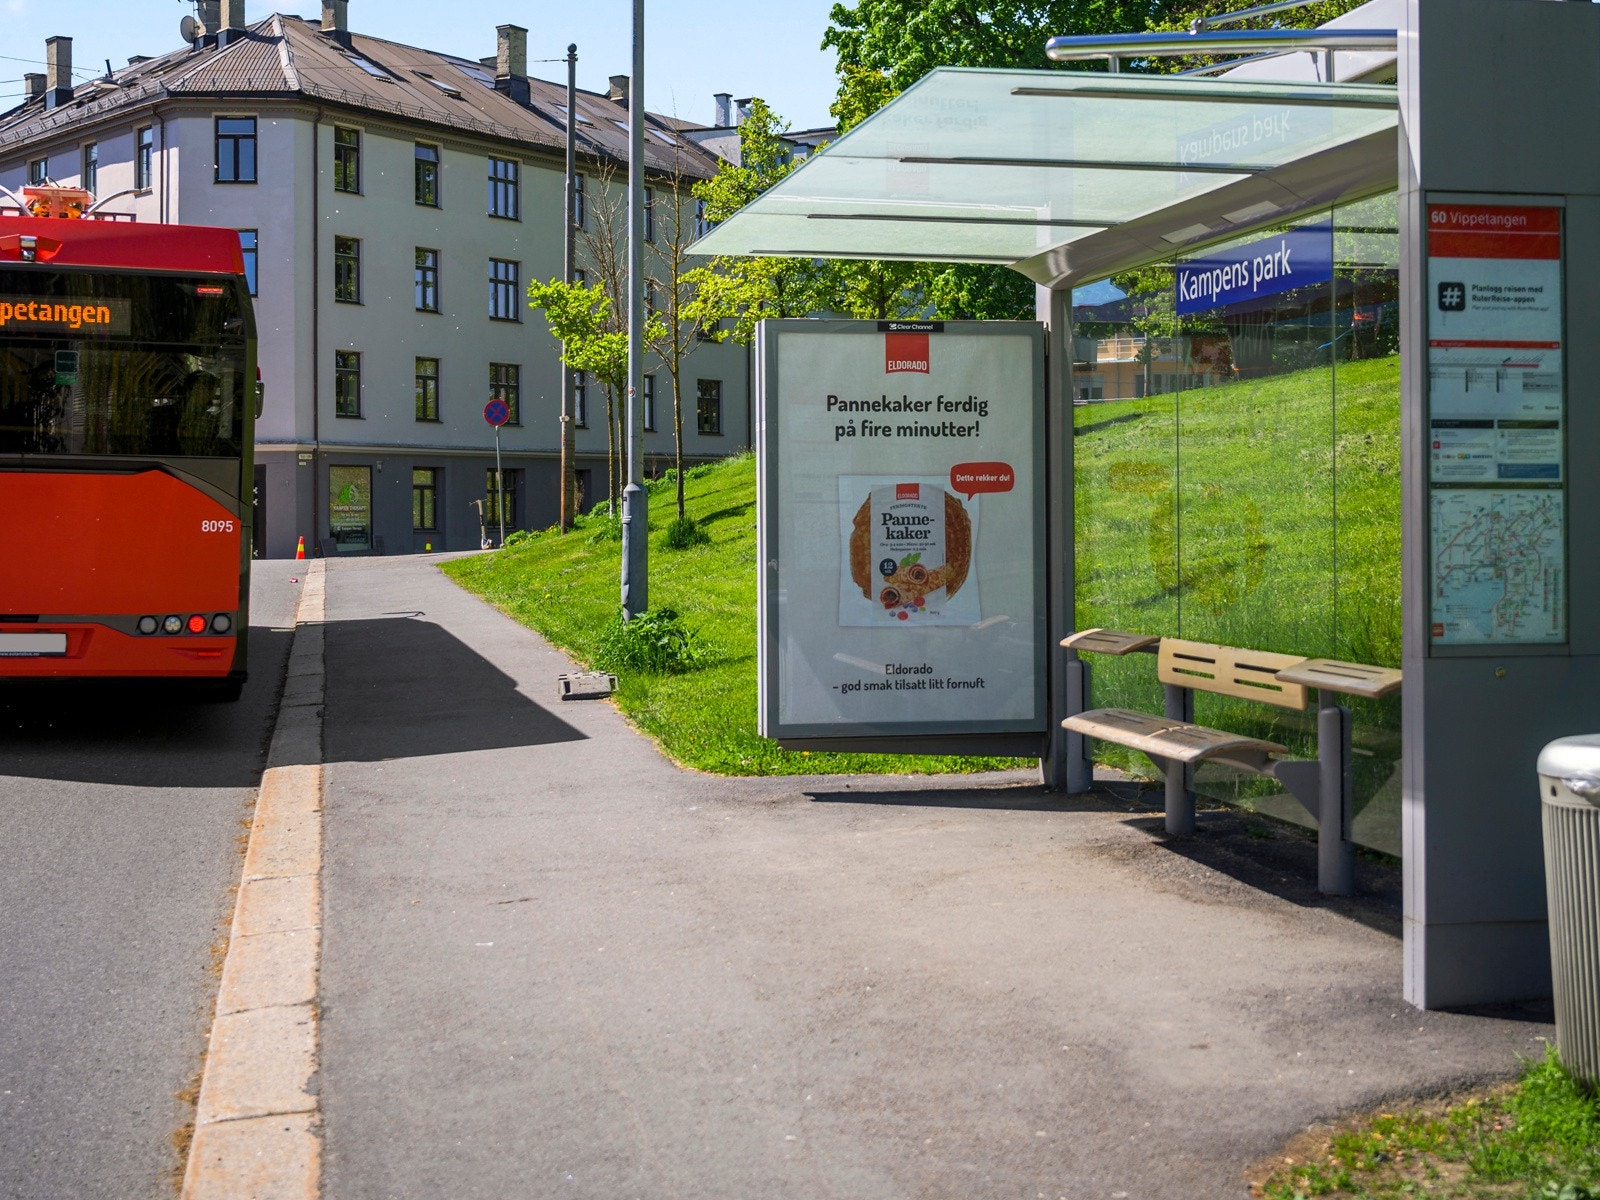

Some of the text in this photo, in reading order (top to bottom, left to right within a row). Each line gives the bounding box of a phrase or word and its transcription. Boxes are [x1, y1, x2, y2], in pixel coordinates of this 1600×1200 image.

[1431, 211, 1527, 228] 60 Vippetangen
[1180, 240, 1292, 302] Kampens park
[1528, 285, 1543, 293] med
[0, 301, 110, 328] petangen
[888, 361, 927, 371] ELDORADO
[826, 395, 988, 417] Pannekaker ferdig
[835, 419, 980, 441] på fire minutter!
[202, 520, 233, 532] 8095
[881, 512, 935, 526] Panne-
[886, 526, 931, 539] kaker
[885, 663, 933, 675] Eldorado
[841, 680, 861, 694] god
[864, 679, 893, 691] smak
[895, 679, 926, 690] tilsatt
[929, 678, 944, 689] litt
[947, 677, 985, 689] fornuft
